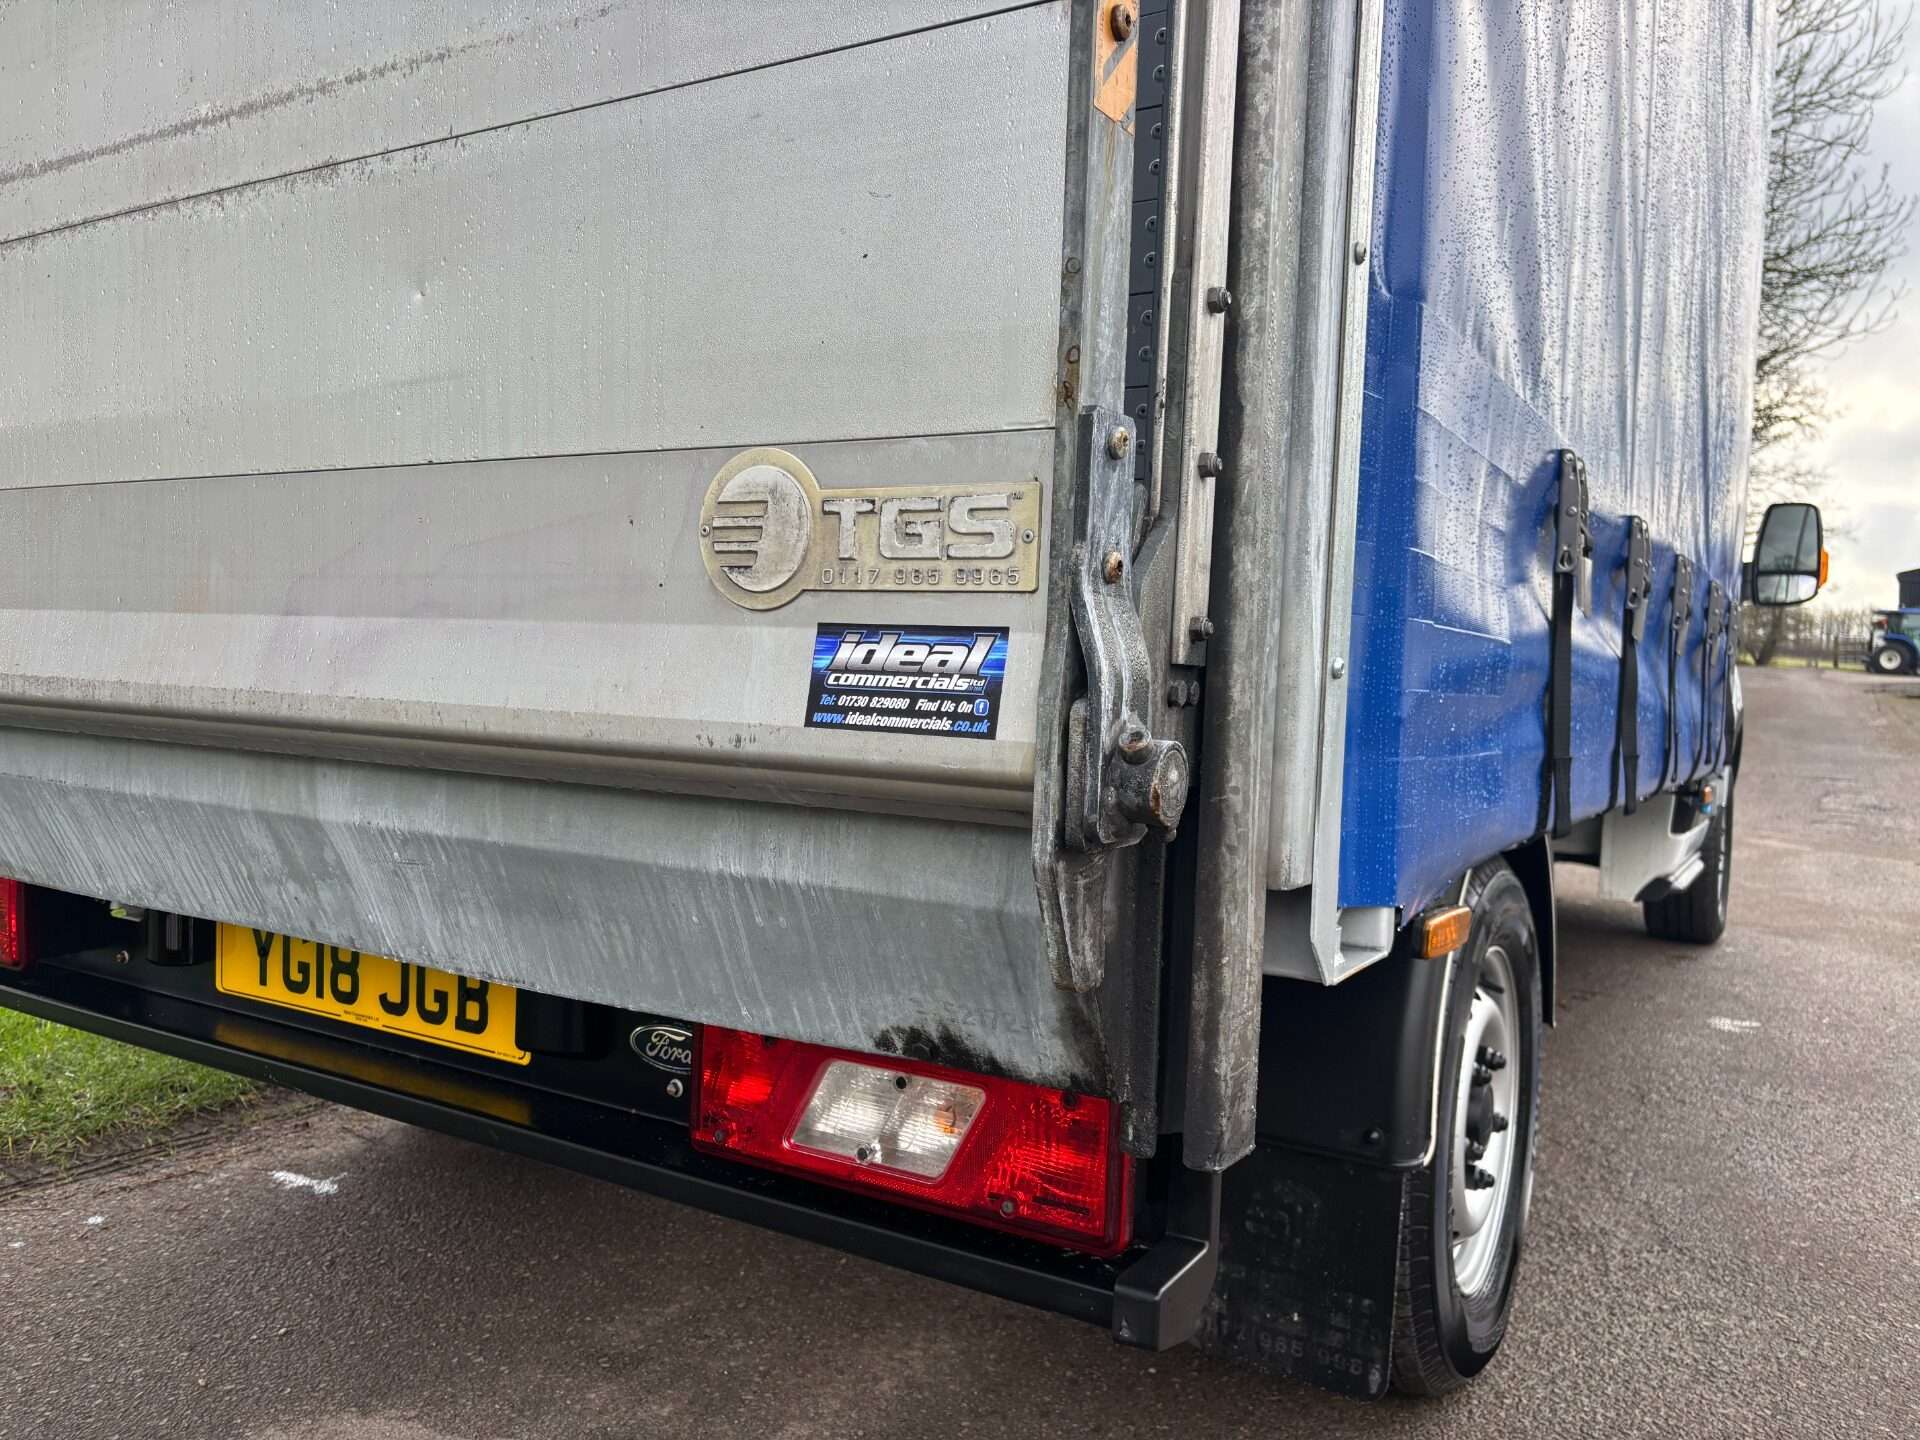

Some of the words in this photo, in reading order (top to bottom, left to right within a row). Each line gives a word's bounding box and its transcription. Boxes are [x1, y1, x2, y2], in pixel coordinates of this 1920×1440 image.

[823, 495, 1016, 560] TGS
[821, 568, 880, 585] 0117
[895, 568, 940, 586] 965
[956, 567, 1019, 586] 9965
[826, 632, 996, 675] ideal
[827, 672, 970, 690] commercials
[819, 694, 837, 706] Tel:
[837, 694, 869, 707] 01730
[869, 696, 911, 710] 829080
[915, 698, 941, 711] Find
[941, 700, 956, 712] Us
[957, 700, 973, 713] On
[812, 711, 991, 733] www.idealcommercials.co.uk
[252, 927, 360, 1006] YG18
